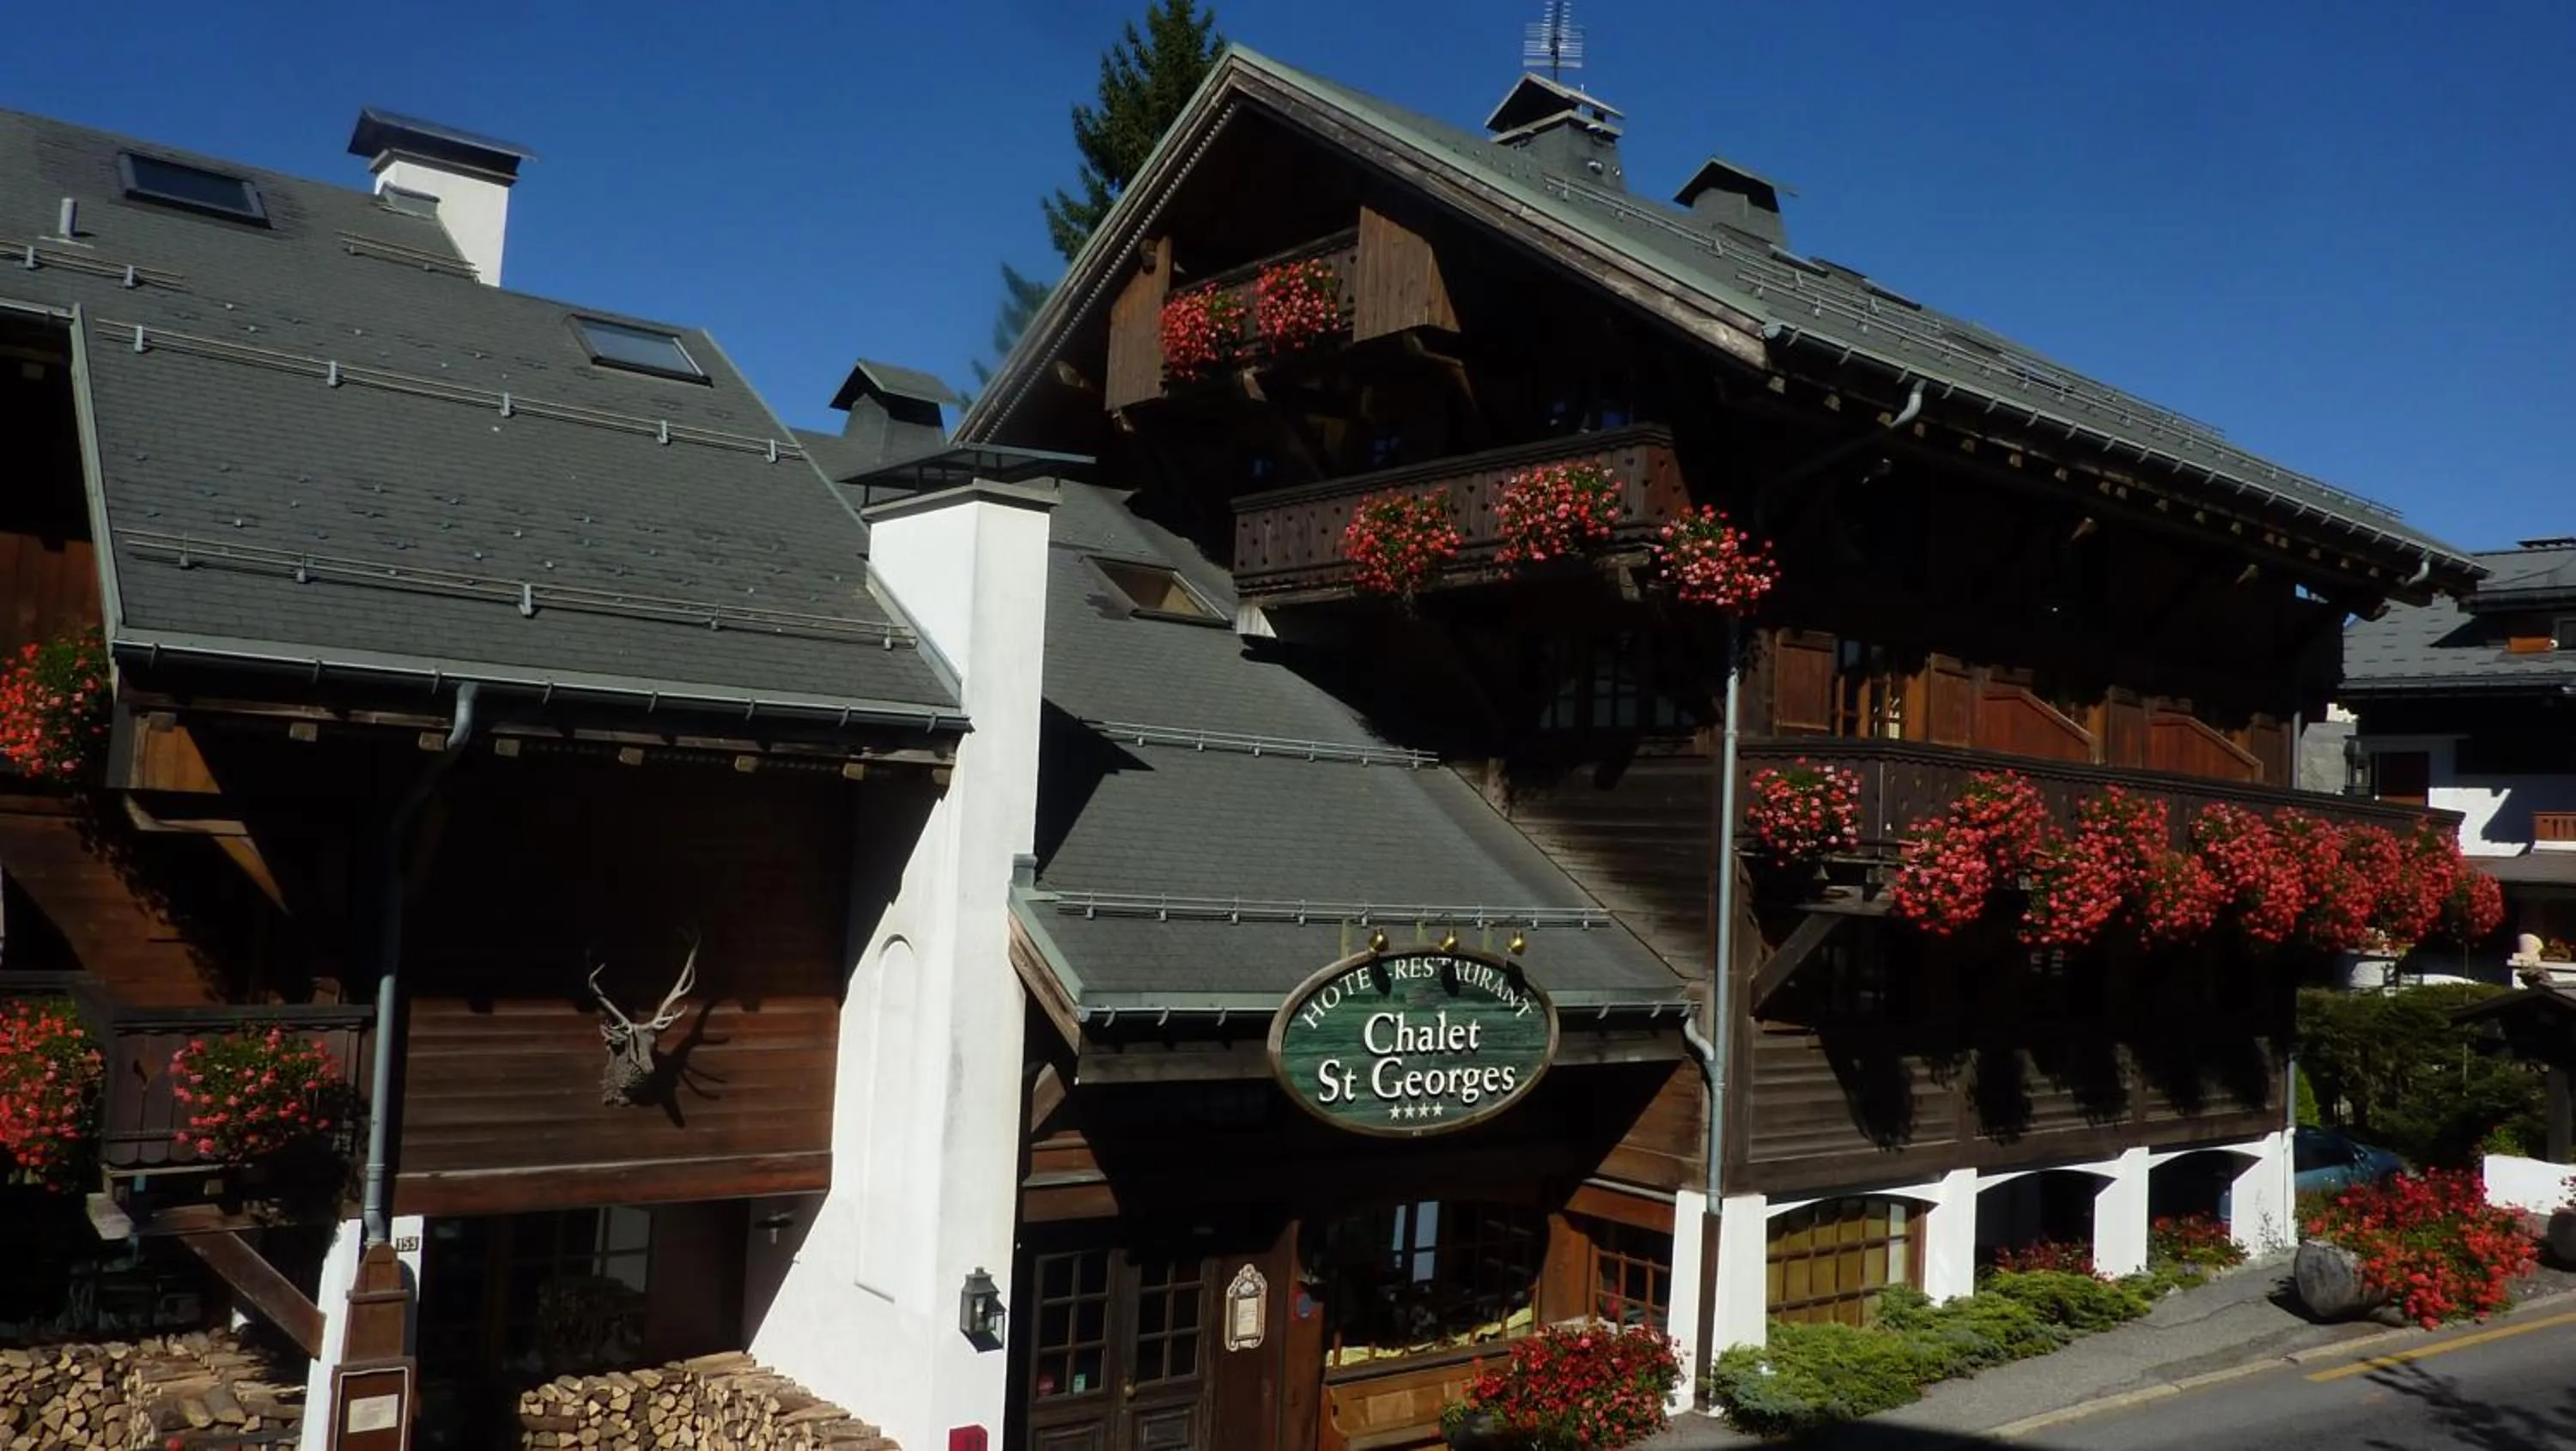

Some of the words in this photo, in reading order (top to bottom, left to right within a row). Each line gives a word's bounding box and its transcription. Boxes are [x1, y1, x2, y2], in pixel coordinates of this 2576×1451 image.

[1364, 1011, 1481, 1055] Chalet
[1318, 1059, 1357, 1102] St
[1371, 1057, 1516, 1103] Georges
